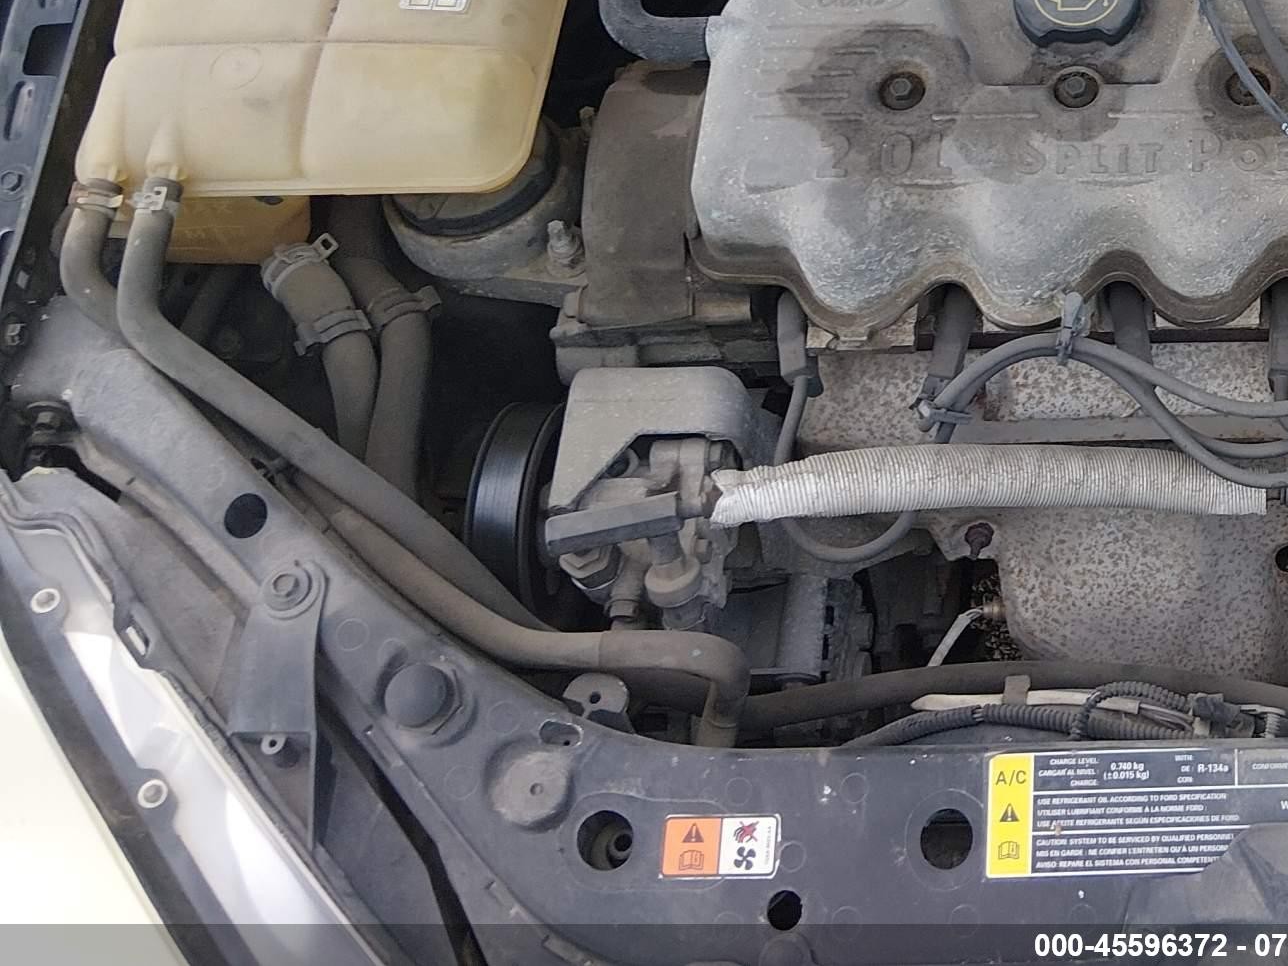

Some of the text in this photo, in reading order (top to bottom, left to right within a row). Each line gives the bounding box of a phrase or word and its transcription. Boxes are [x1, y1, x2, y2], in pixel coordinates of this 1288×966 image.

[1016, 138, 1164, 178] SPLIT
[1049, 757, 1076, 766] CHARGE
[1110, 761, 1145, 772] 0.740 kg
[1197, 763, 1229, 773] R-134a
[995, 770, 1027, 787] A/C
[1135, 770, 1150, 781] kg)
[1037, 797, 1051, 806] USE
[1052, 796, 1097, 805] REFRIGERANT
[1110, 795, 1148, 804] ACCORDING
[1150, 794, 1159, 802] TO
[1067, 807, 1105, 816] LUBRIFIANT
[1106, 806, 1143, 814] CONFORME
[1150, 805, 1160, 813] LA
[1037, 820, 1051, 828] USE
[1075, 818, 1124, 826] REFRIGERANTE
[1150, 815, 1210, 824] ESPECIFICACIONES
[1069, 837, 1097, 845] SYSTEM
[1118, 836, 1150, 844] SERVICED
[1151, 835, 1160, 843] BY
[1161, 834, 1195, 842] QUALIFIED
[1061, 849, 1083, 857] GARDE
[1098, 848, 1127, 856] CONFIER
[1188, 845, 1198, 853] UN
[1059, 860, 1084, 868] REPARE
[1094, 859, 1124, 867] SISTEMA
[1125, 858, 1140, 866] CON
[1141, 857, 1176, 865] PERSONAL
